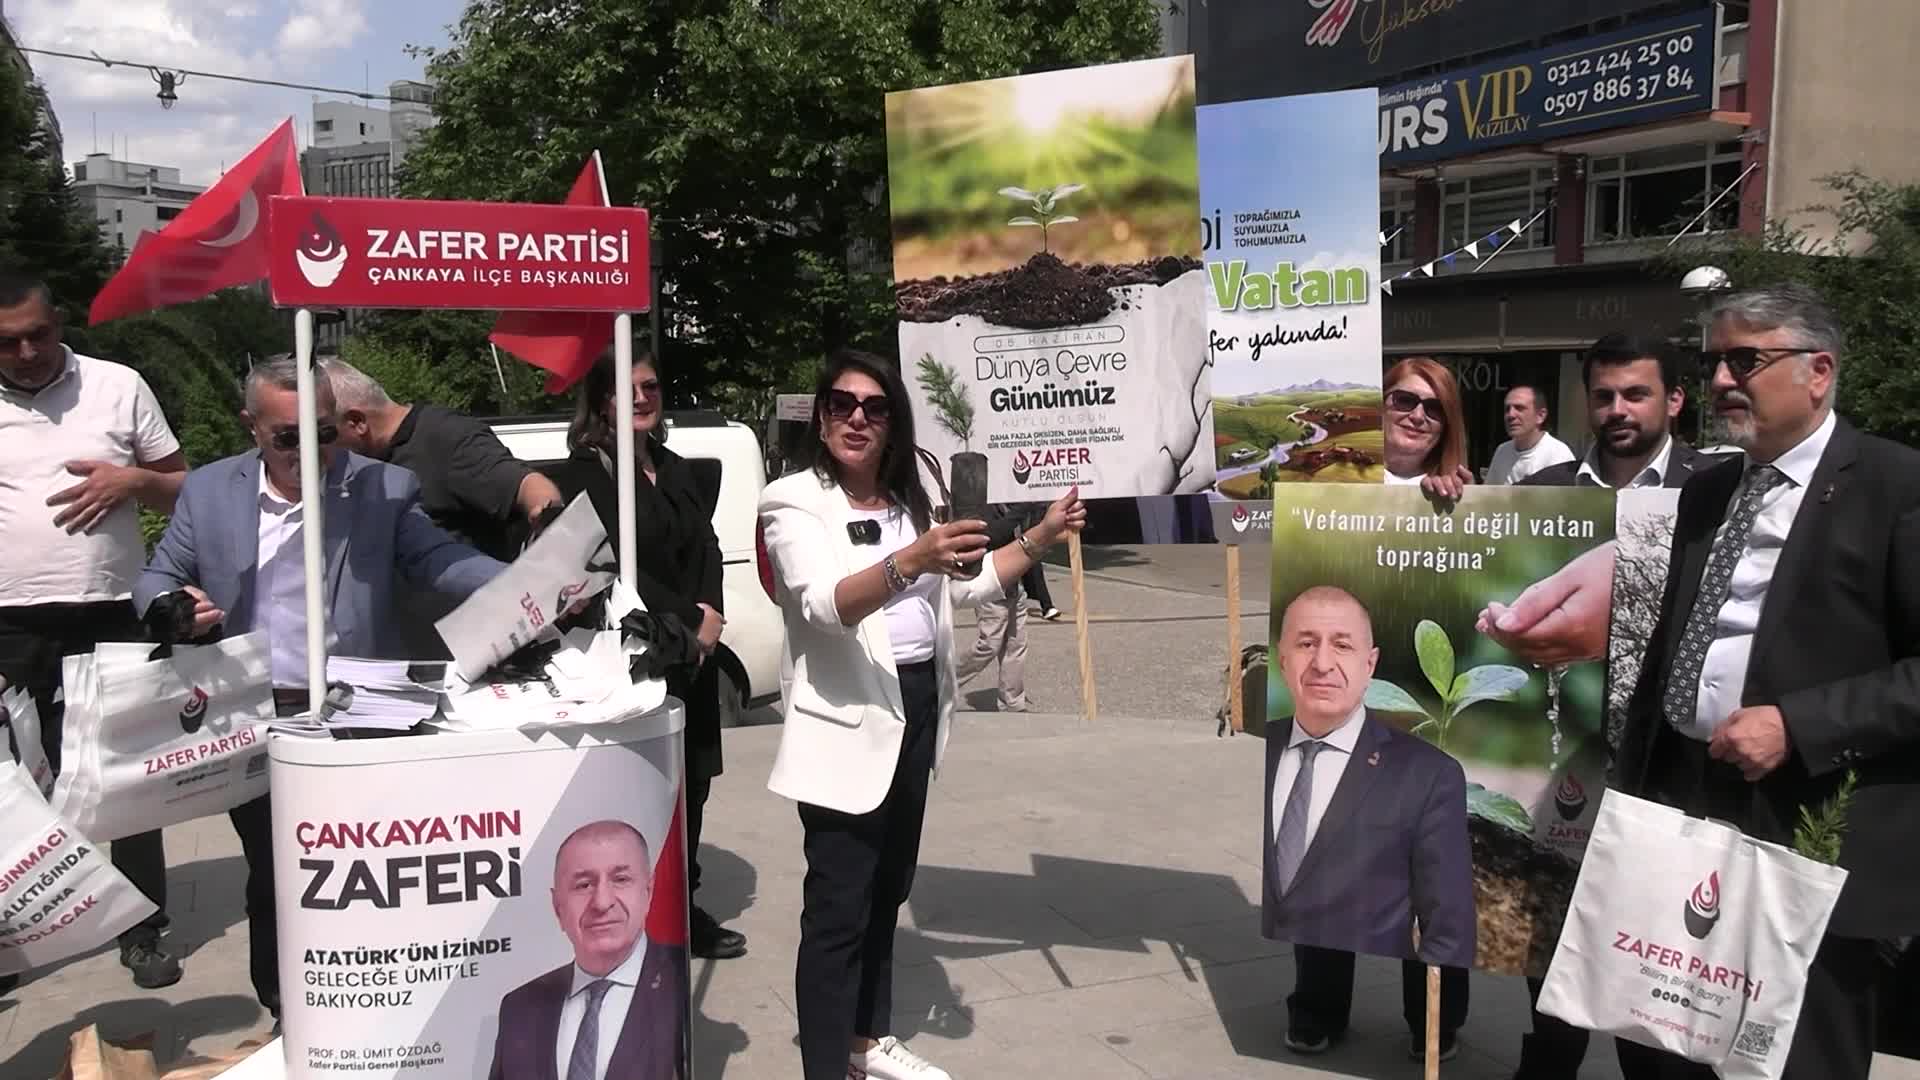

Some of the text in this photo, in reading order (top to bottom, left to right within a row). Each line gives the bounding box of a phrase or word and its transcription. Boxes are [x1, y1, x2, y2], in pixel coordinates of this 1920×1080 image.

[1547, 35, 1693, 83] 0312 424 25 00
[1456, 65, 1533, 140] VIP
[1544, 65, 1694, 116] 0507 886 37 84
[1378, 98, 1449, 156] URS
[1476, 115, 1530, 139] KIZILAY
[1234, 209, 1301, 224] TOPRAĞIMIZLA
[1234, 223, 1289, 236] SUYUMUZLA
[367, 228, 629, 263] ZAFER PARTİSİ
[1234, 234, 1306, 248] TOHUMUMUZLA
[368, 266, 629, 287] ÇANKAYA İLÇE BAŞKANLIĞI
[1208, 260, 1369, 312] Vatan
[1208, 315, 1348, 367] fer yakında!
[976, 350, 1127, 384] Dünya Çevre
[1456, 361, 1508, 391] KOL
[990, 380, 1116, 413] Günümüz
[990, 433, 1009, 441] DAHA
[1067, 428, 1087, 437] DAHA
[1031, 447, 1092, 467] ZAFER
[1039, 466, 1080, 481] PARTİSİ
[1251, 510, 1272, 520] ZAF
[1251, 521, 1273, 529] PAR
[1291, 508, 1595, 540] “Vefamız ranta değil vatan
[1376, 545, 1496, 573] toprağına”
[144, 748, 196, 776] ZAFER
[198, 727, 257, 759] PARTİSİ
[296, 809, 521, 854] ÇANKAYA’NIN
[2, 845, 91, 922] ALKTIĞINDA
[299, 846, 522, 911] ZAFERİ
[15, 895, 99, 946] DOLACAK
[30, 887, 76, 924] DAHA
[304, 937, 513, 966] ATATÜRK’ÜN İZİNDE
[1613, 931, 1763, 1002] ZAFER PARTSİ
[304, 962, 480, 988] GELECEĞE ÜMİT’LE
[305, 990, 413, 1009] BAKIYORUZ
[308, 1042, 442, 1060] PROF. DR. ÜMİT ÖZDAĞ
[308, 1057, 444, 1071] Zafer Partisi Genel Başkanı
